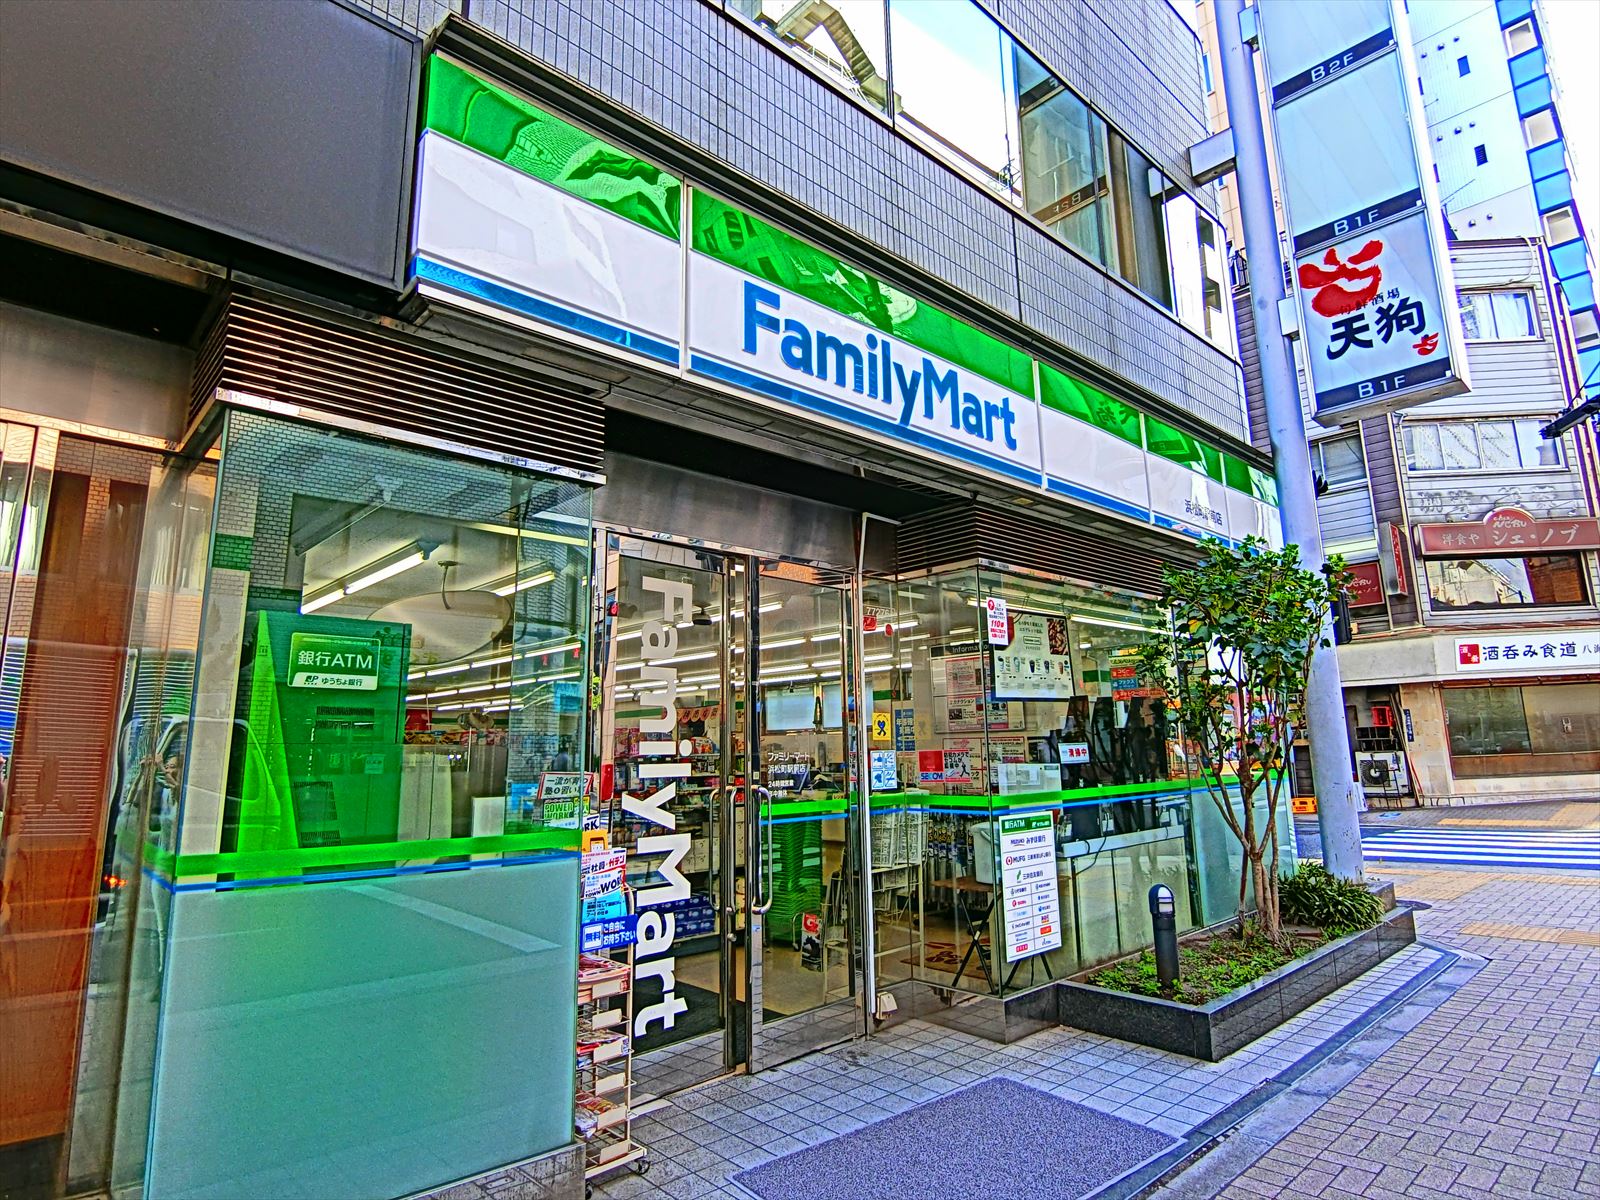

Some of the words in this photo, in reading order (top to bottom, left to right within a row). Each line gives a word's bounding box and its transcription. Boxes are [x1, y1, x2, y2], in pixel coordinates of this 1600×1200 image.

[1311, 52, 1354, 83] B2F
[1333, 209, 1379, 236] B1F
[1327, 296, 1426, 360] 天狗
[742, 280, 1017, 450] FamilyMart
[1358, 374, 1406, 399] B1F
[1441, 533, 1480, 545] 洋食や
[1492, 523, 1580, 546] シェ・ノブ
[952, 644, 991, 654] Informao
[1482, 641, 1578, 661] 酒呑み食道
[298, 650, 373, 669] 銀行ATM
[321, 677, 363, 687] ゆうちょ銀行
[767, 752, 810, 762] ファミリーマート
[767, 763, 807, 775] 浜松町駅前店
[544, 802, 574, 813] POWER
[622, 576, 692, 1038] FamilyMart
[600, 874, 622, 893] WOR
[585, 931, 601, 942] 無料
[603, 921, 626, 933] ご自由に
[603, 930, 636, 945] お持ち下さい
